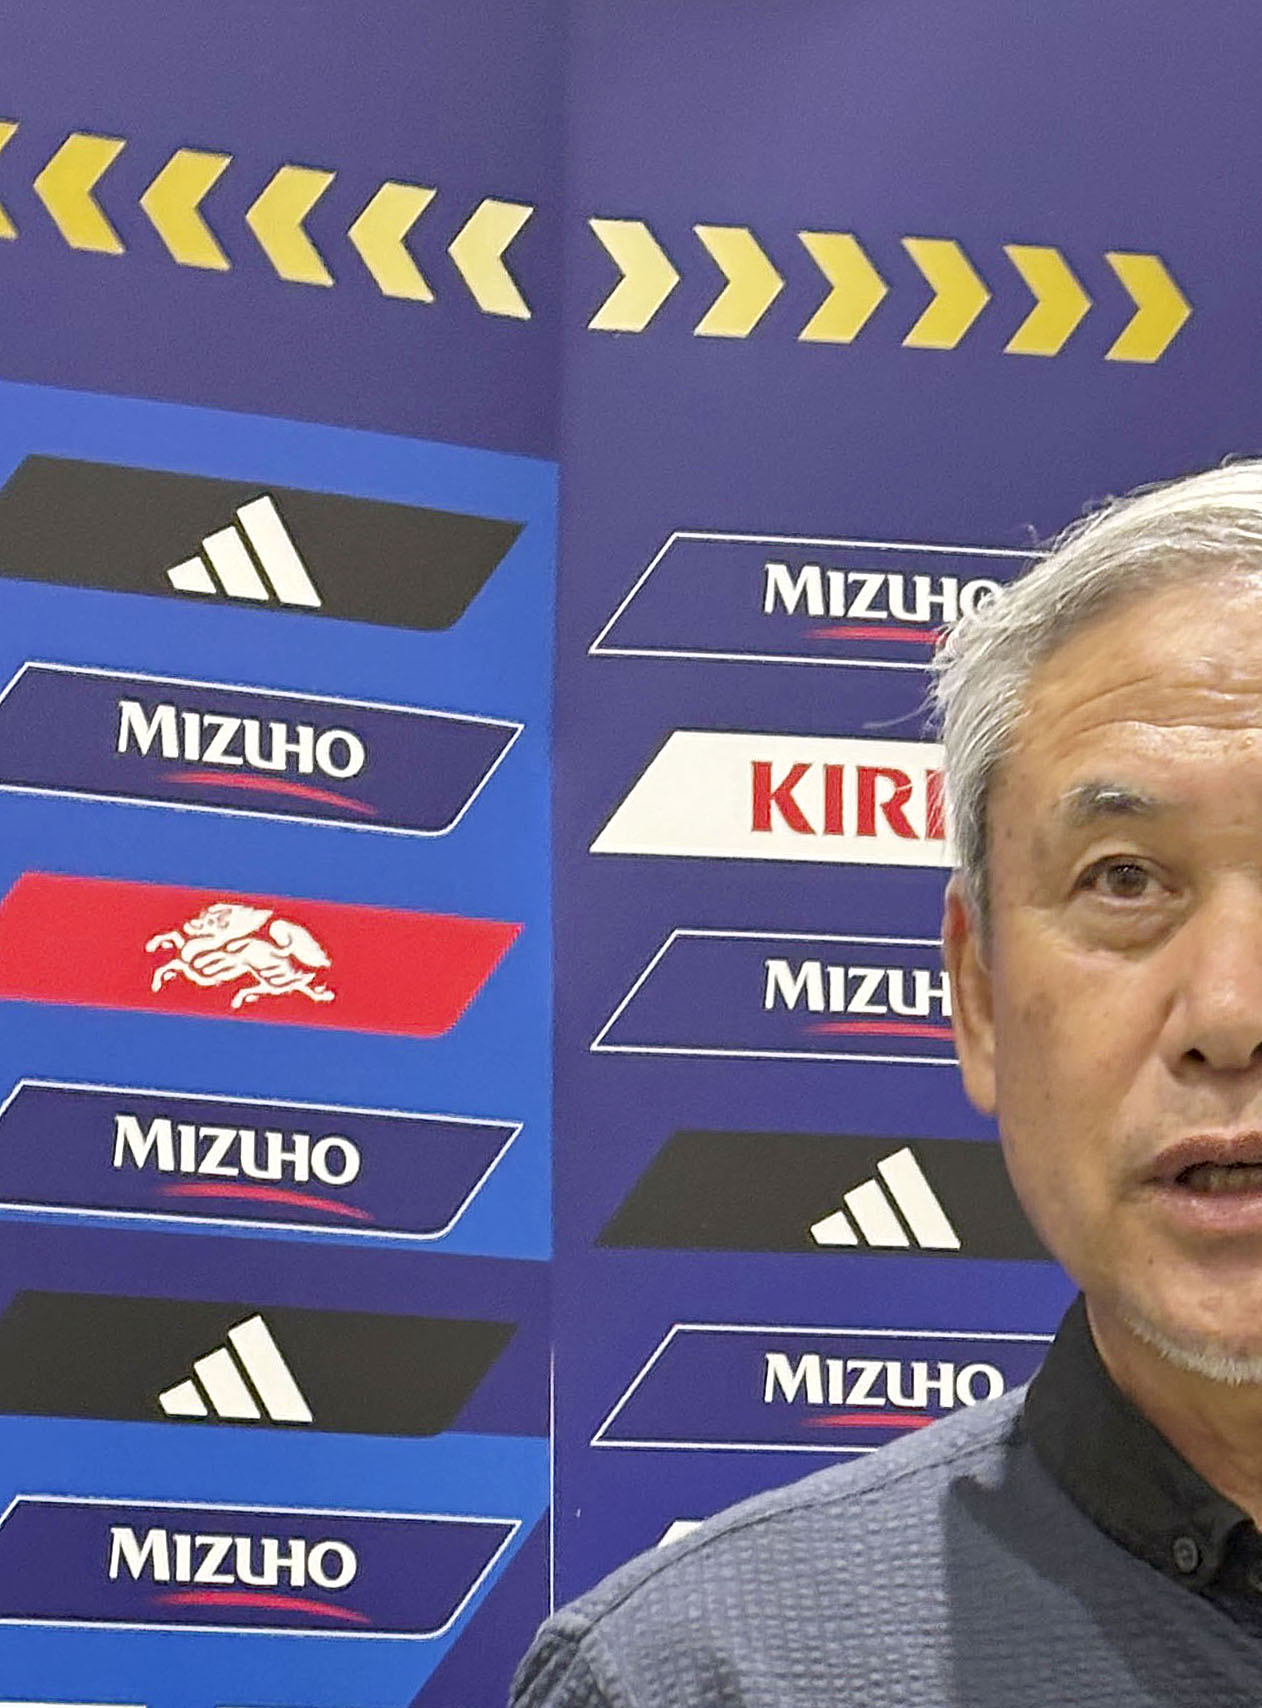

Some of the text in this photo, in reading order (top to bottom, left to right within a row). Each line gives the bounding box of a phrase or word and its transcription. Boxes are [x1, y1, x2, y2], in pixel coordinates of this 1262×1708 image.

[117, 699, 365, 778] MIZUHO
[751, 761, 946, 840] KIRI
[764, 959, 951, 1018] MIZUH
[113, 1115, 361, 1185] MIZUHO
[764, 1352, 1004, 1408] MIZUHO
[108, 1526, 357, 1589] MIZUHO
